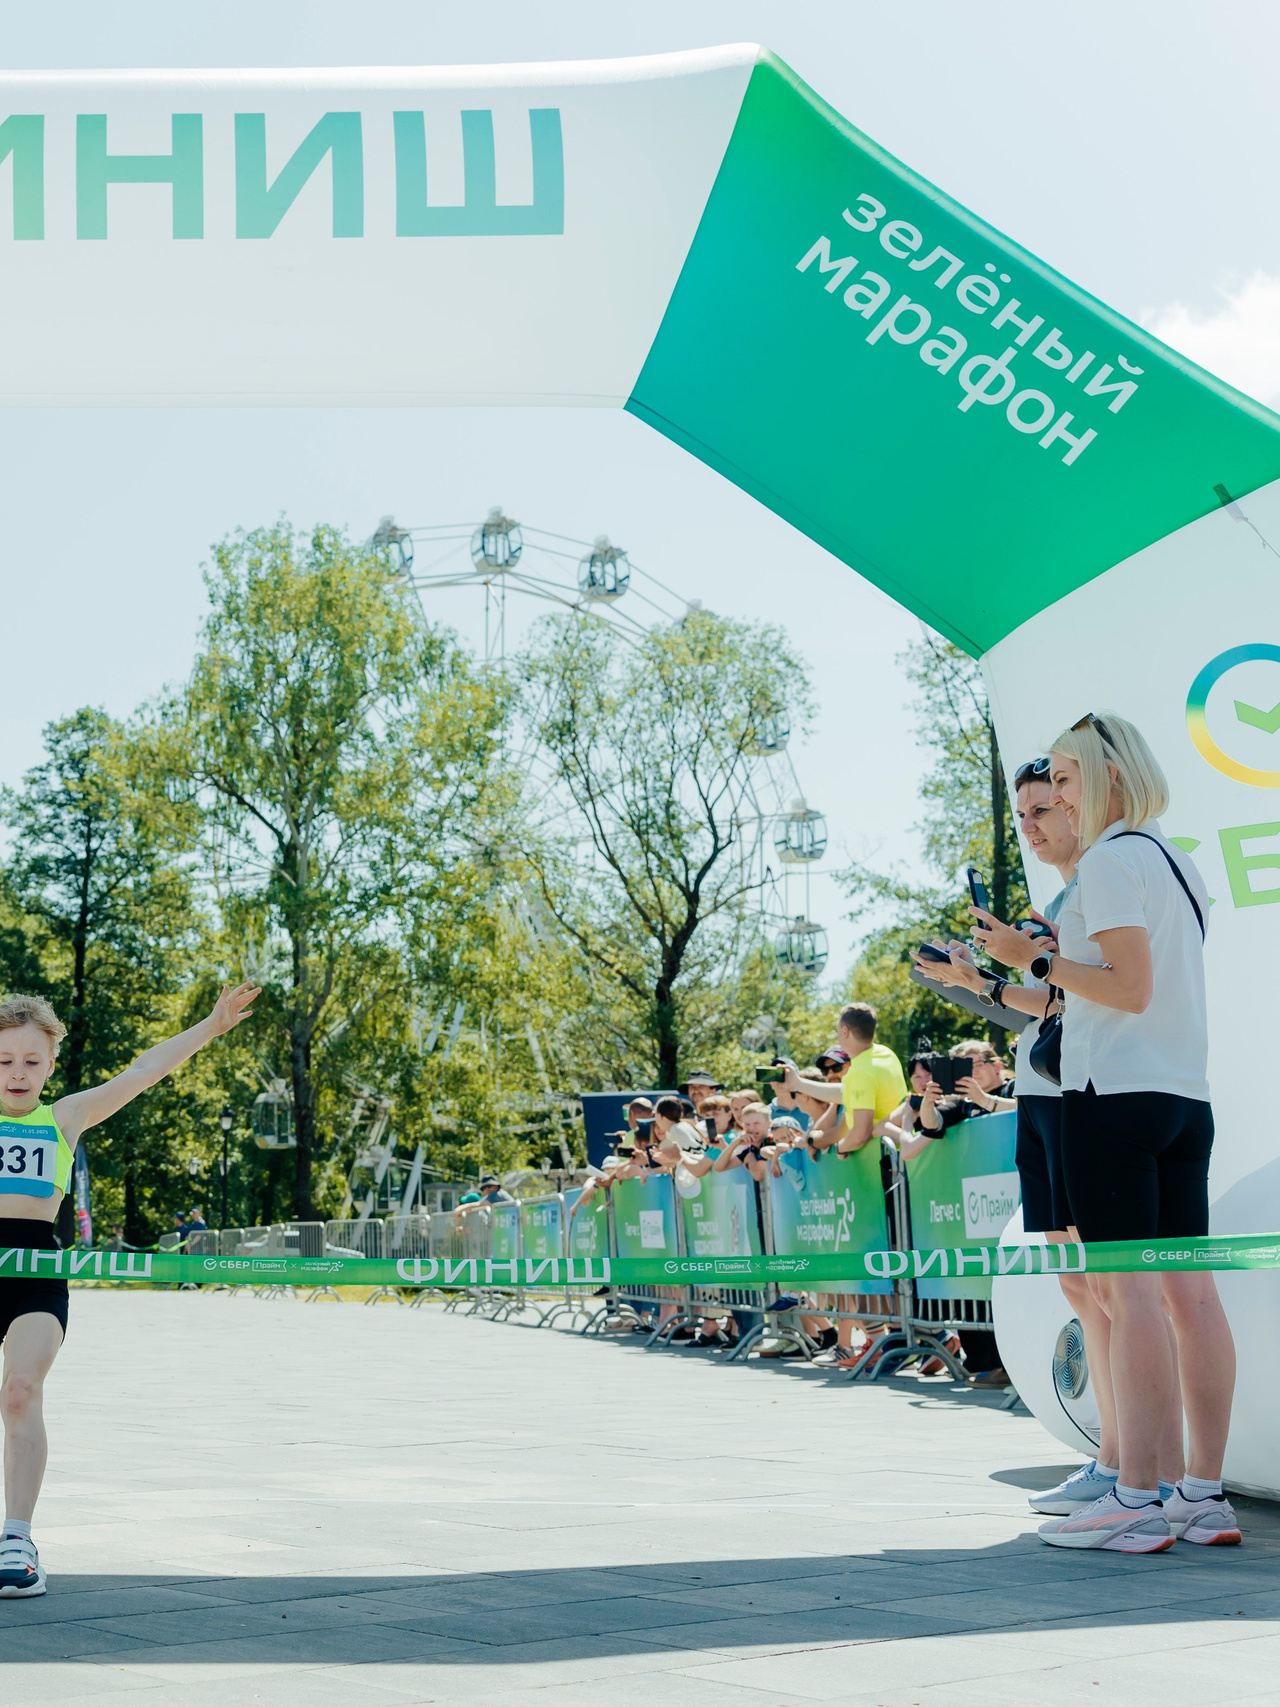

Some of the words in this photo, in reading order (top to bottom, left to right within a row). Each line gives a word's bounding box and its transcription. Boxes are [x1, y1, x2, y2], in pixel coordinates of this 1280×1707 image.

[841, 192, 1145, 415] зелёный
[795, 235, 1099, 467] марафон
[799, 1190, 836, 1217] зелёный
[929, 1200, 954, 1223] Легче
[955, 1202, 961, 1221] с
[980, 1190, 1014, 1223] Прайм
[796, 1217, 835, 1247] марафон
[219, 1260, 251, 1270] СБЕР
[255, 1261, 281, 1271] Прайм
[680, 1262, 713, 1272] СБЕР
[718, 1261, 745, 1271] Прайм
[863, 1241, 1087, 1279] ФИНИШ
[1158, 1250, 1192, 1260] СБЕР
[1197, 1250, 1224, 1260] Прайм
[396, 1257, 612, 1284] ФИНИШ
